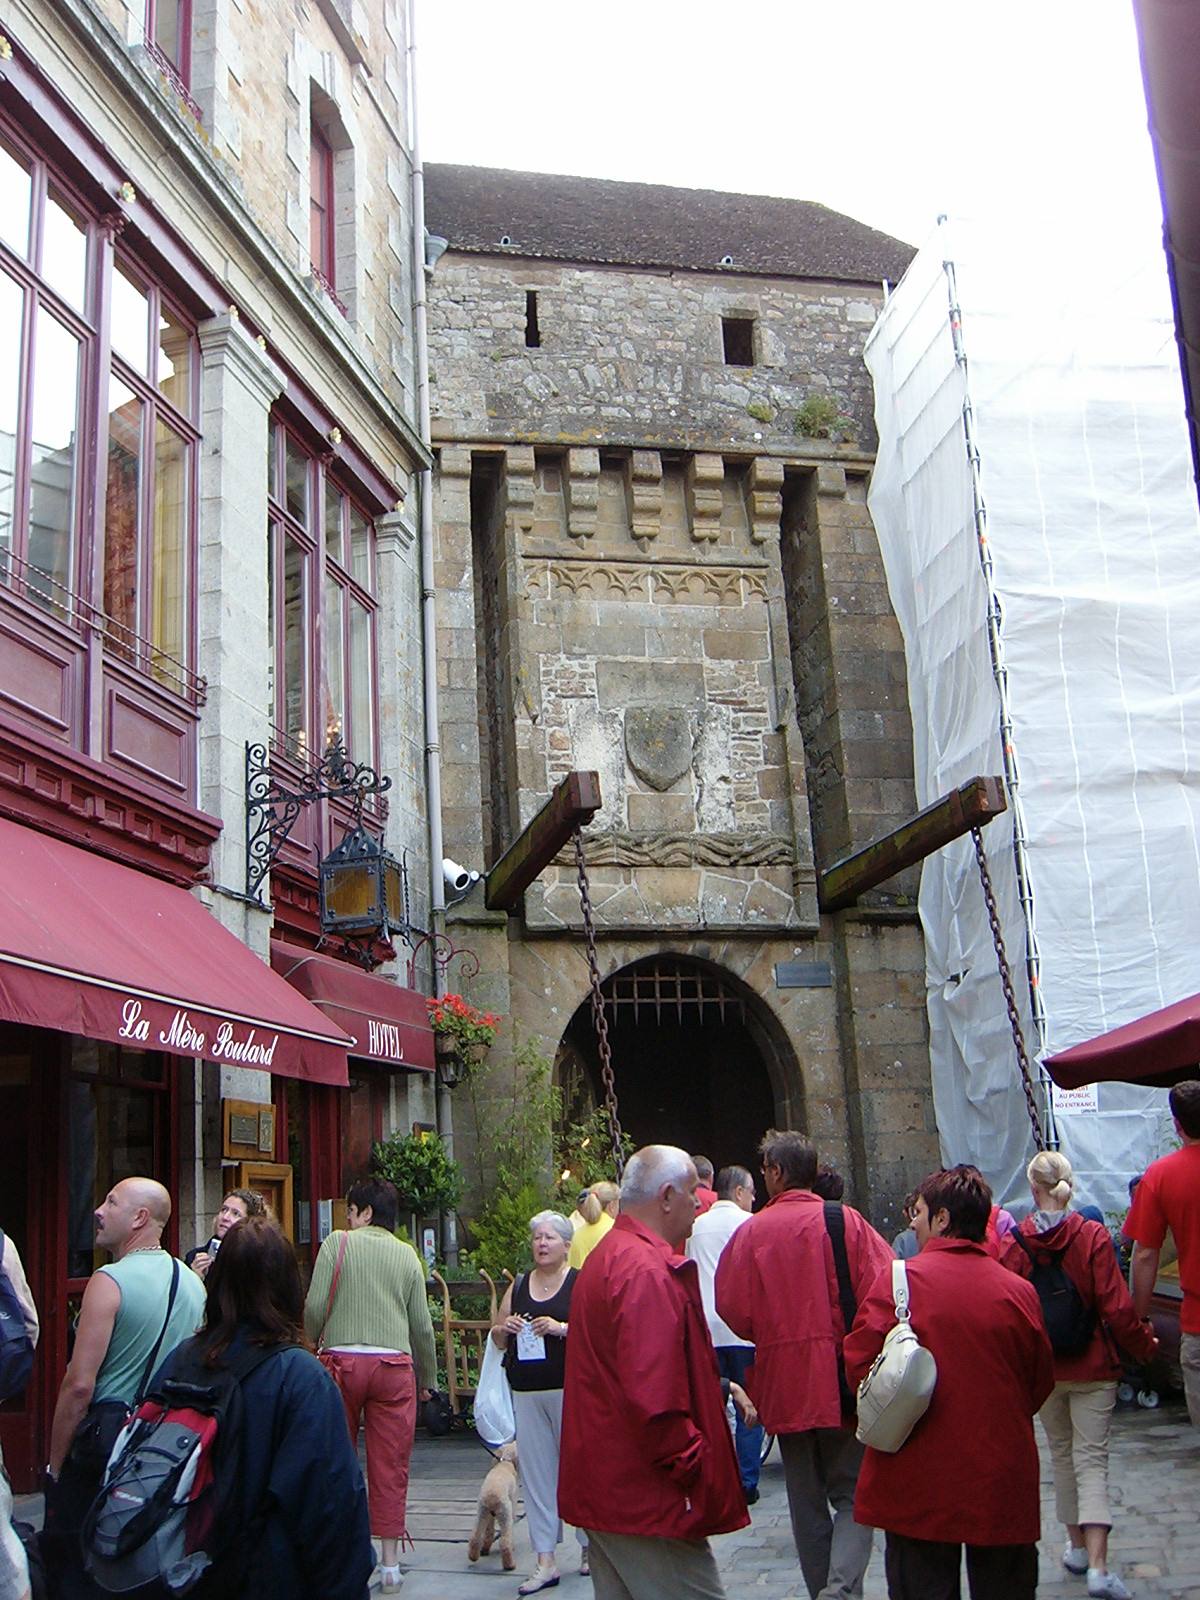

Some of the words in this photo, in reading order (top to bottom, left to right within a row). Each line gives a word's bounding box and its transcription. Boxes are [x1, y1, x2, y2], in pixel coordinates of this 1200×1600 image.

[118, 999, 150, 1040] La
[159, 1010, 204, 1051] Mère
[212, 1021, 279, 1066] Poulard
[368, 1020, 403, 1060] HOTEL
